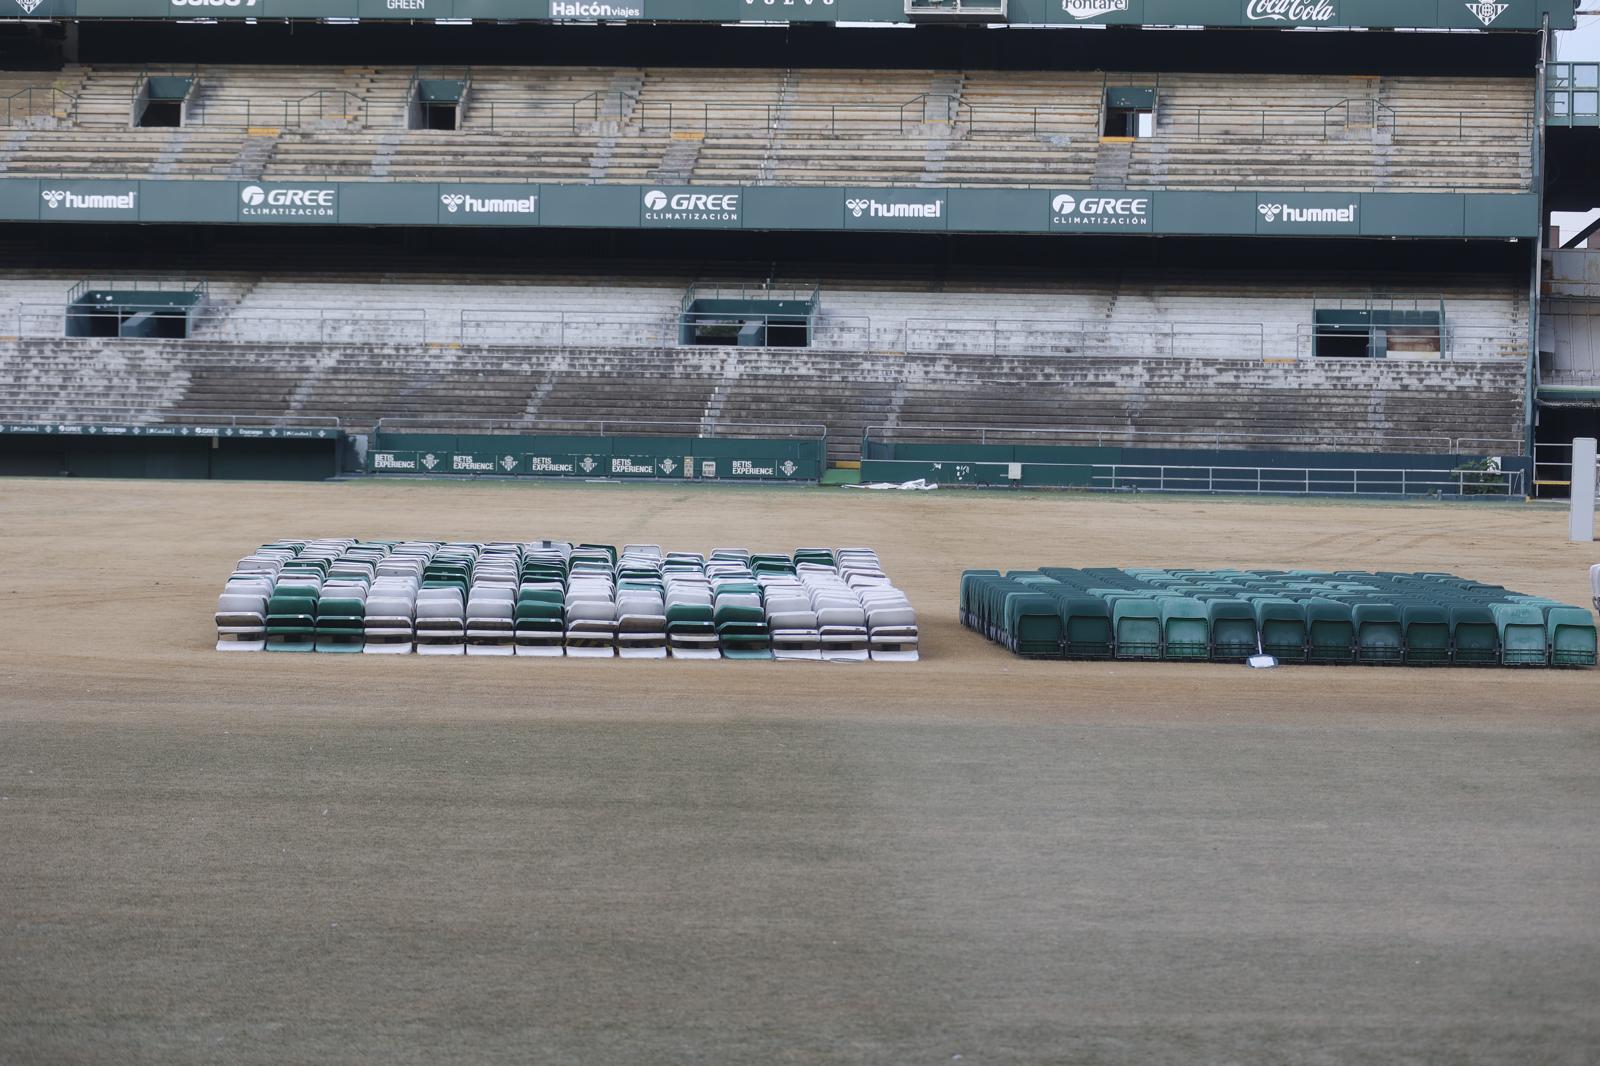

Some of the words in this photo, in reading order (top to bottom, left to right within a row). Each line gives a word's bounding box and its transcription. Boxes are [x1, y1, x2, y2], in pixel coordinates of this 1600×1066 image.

[387, 0, 425, 9] GREEN
[552, 2, 612, 16] Halcón
[612, 7, 640, 18] viajes
[65, 191, 133, 208] hummel
[268, 190, 335, 206] GREE
[670, 194, 738, 211] GREE
[465, 195, 535, 213] hummel
[870, 199, 941, 218] hummel
[1079, 198, 1148, 215] GREE
[243, 206, 334, 216] CLIMATIZACIÓN
[646, 211, 737, 221] CLIMATIZACIÓN
[1283, 203, 1354, 222] hummel
[1053, 215, 1147, 225] CLIMATIZACIÓN
[374, 460, 415, 468] EXPERIENCE
[453, 462, 494, 470] EXPERIENCE
[532, 464, 573, 472] EXPERIENCE
[612, 465, 653, 473] EXPERIENCE
[732, 467, 774, 475] EXPERIENCE
